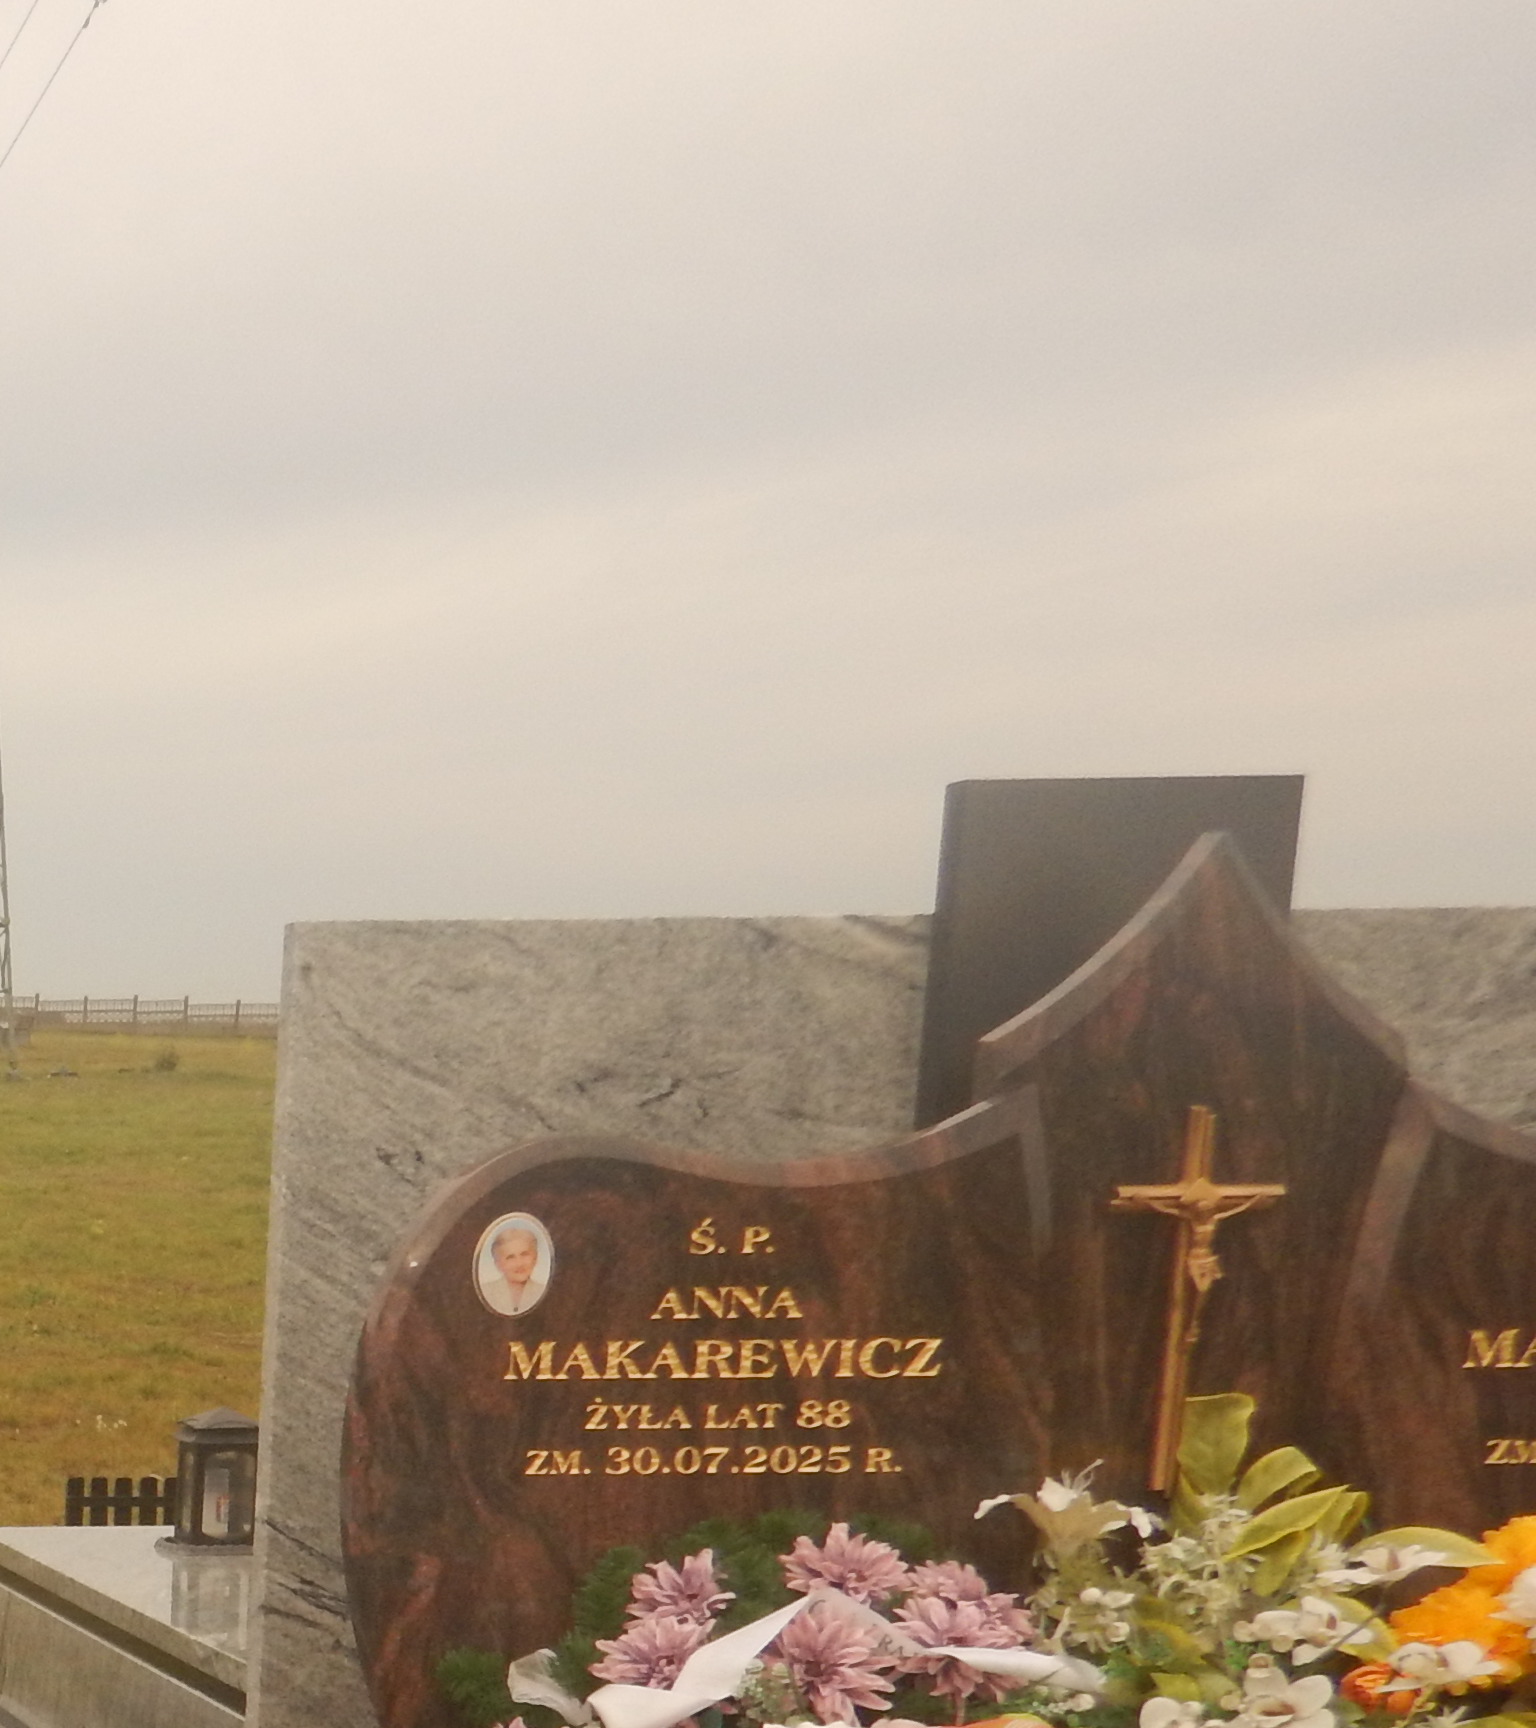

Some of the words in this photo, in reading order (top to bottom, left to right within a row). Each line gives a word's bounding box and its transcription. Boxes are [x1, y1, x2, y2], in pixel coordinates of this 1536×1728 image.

[690, 1217, 726, 1255] Ś.
[741, 1227, 775, 1255] P.
[650, 1287, 803, 1320] ANNA
[503, 1337, 943, 1381] MAKAREWICZ
[585, 1397, 692, 1431] ŻYŁA
[703, 1403, 785, 1430] LAT
[796, 1400, 853, 1429] 88
[525, 1449, 591, 1476] ZM.
[604, 1446, 853, 1476] 30.07.2025
[864, 1448, 903, 1474] R.
